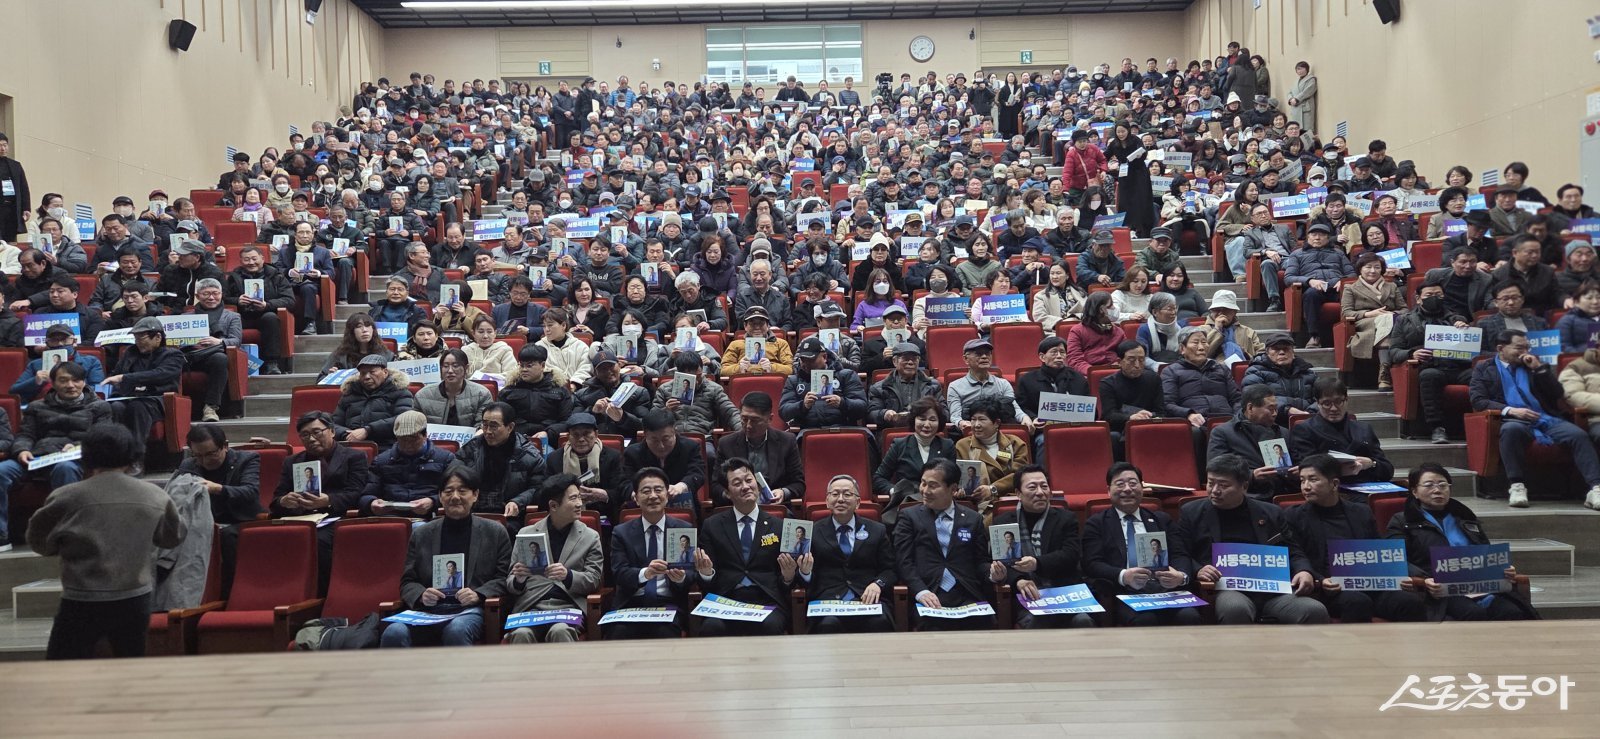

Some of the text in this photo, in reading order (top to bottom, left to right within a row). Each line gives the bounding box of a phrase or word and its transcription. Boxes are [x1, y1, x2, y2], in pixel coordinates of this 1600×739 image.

[1411, 201, 1435, 209] 서동욱의
[927, 303, 955, 313] 서동욱의
[984, 299, 1025, 311] 서동욱의 진심
[192, 319, 207, 329] 진심
[1427, 332, 1481, 343] 서동욱의 진심
[1541, 335, 1560, 348] 진심
[423, 362, 439, 374] 진심
[1041, 401, 1094, 413] 서동욱의 진심
[1215, 553, 1288, 568] 서동욱의 진심
[1332, 548, 1406, 567] 서동욱의 진심
[1435, 551, 1509, 573] 서동욱의 진심
[1225, 578, 1280, 592] 출판기념회
[1343, 578, 1397, 590] 출판기념회
[1026, 589, 1092, 608] 서동욱의 진심
[697, 605, 766, 618] 서동욱의 진심
